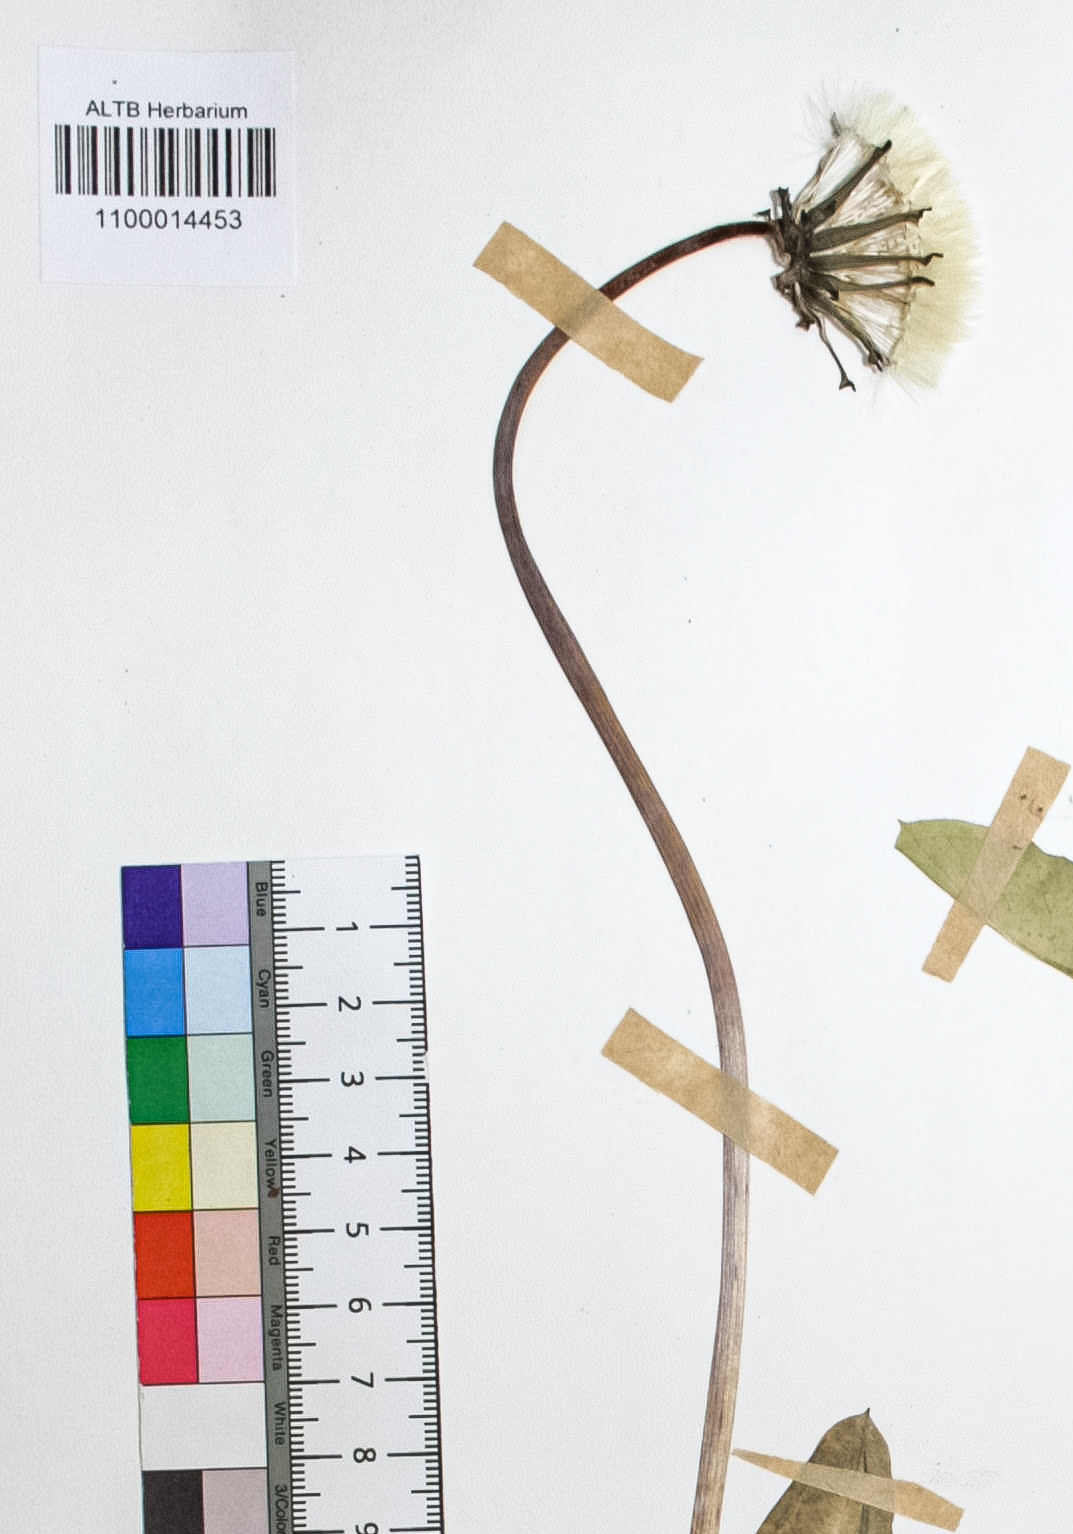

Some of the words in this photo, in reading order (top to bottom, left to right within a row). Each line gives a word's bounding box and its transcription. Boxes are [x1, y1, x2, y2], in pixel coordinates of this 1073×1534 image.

[86, 100, 140, 118] ALTB
[148, 101, 247, 119] Herbarium
[96, 208, 242, 230] 1100014453
[256, 882, 268, 917] Blue
[336, 922, 359, 931] 1
[258, 969, 271, 1008] Cyan
[338, 996, 361, 1012] 2
[261, 1051, 272, 1098] Green
[341, 1071, 364, 1087] 3
[343, 1146, 367, 1163] 4
[346, 1222, 369, 1238] 5
[267, 1236, 280, 1266] Red
[348, 1297, 372, 1313] 6
[268, 1304, 282, 1371] Magenta
[351, 1372, 374, 1388] 7
[273, 1402, 287, 1445] White
[353, 1448, 376, 1463] 8
